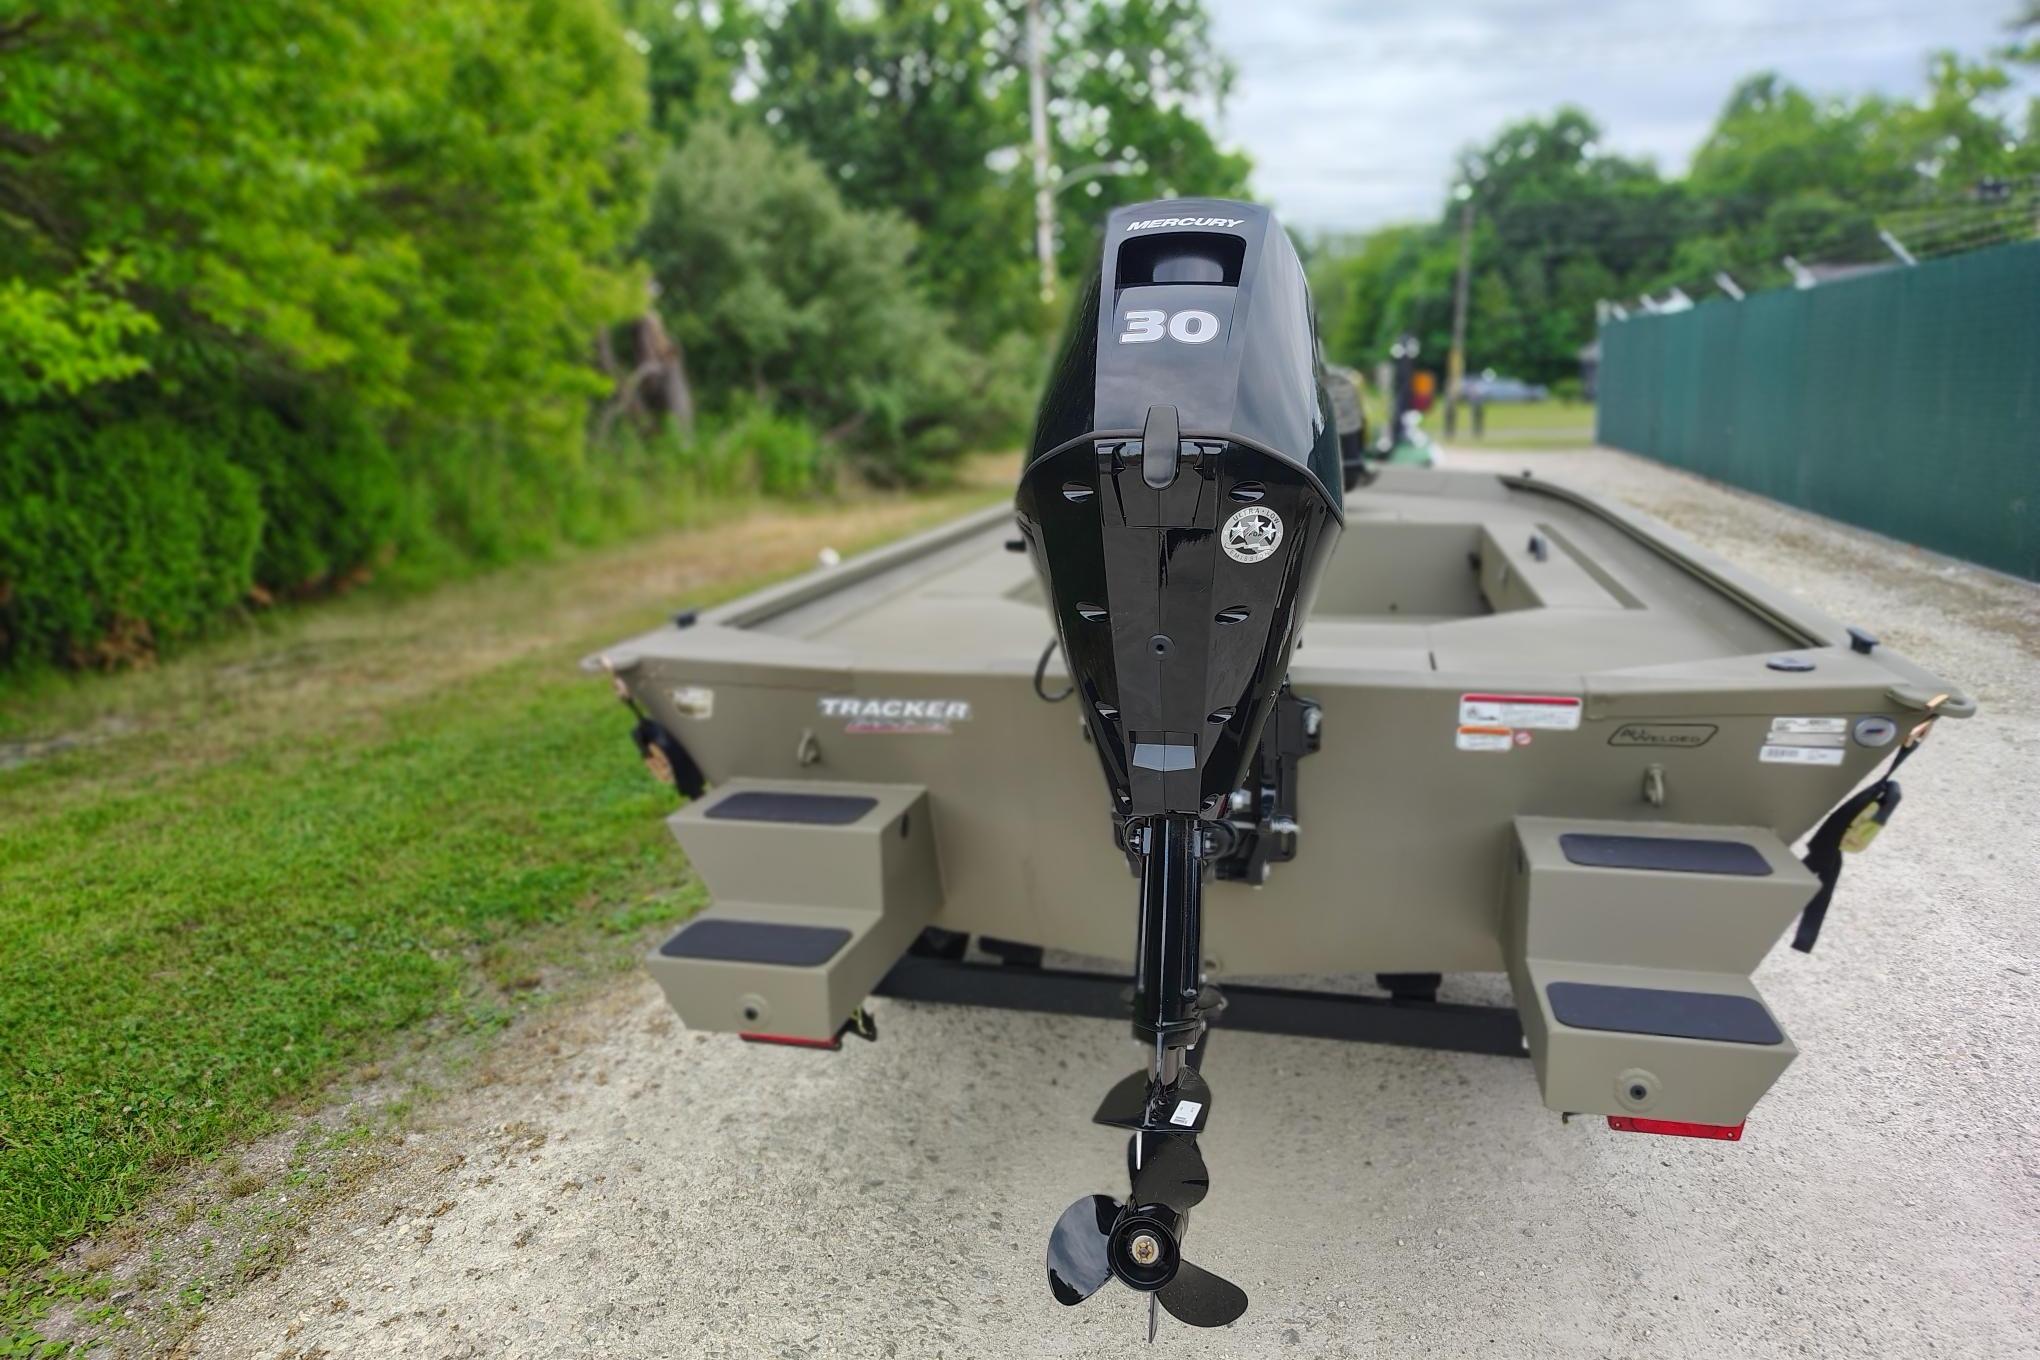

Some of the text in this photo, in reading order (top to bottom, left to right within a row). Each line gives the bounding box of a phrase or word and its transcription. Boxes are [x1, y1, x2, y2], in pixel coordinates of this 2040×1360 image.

[1126, 217, 1245, 232] MERCURY
[1119, 309, 1221, 344] 30
[819, 697, 971, 719] TRACKER
